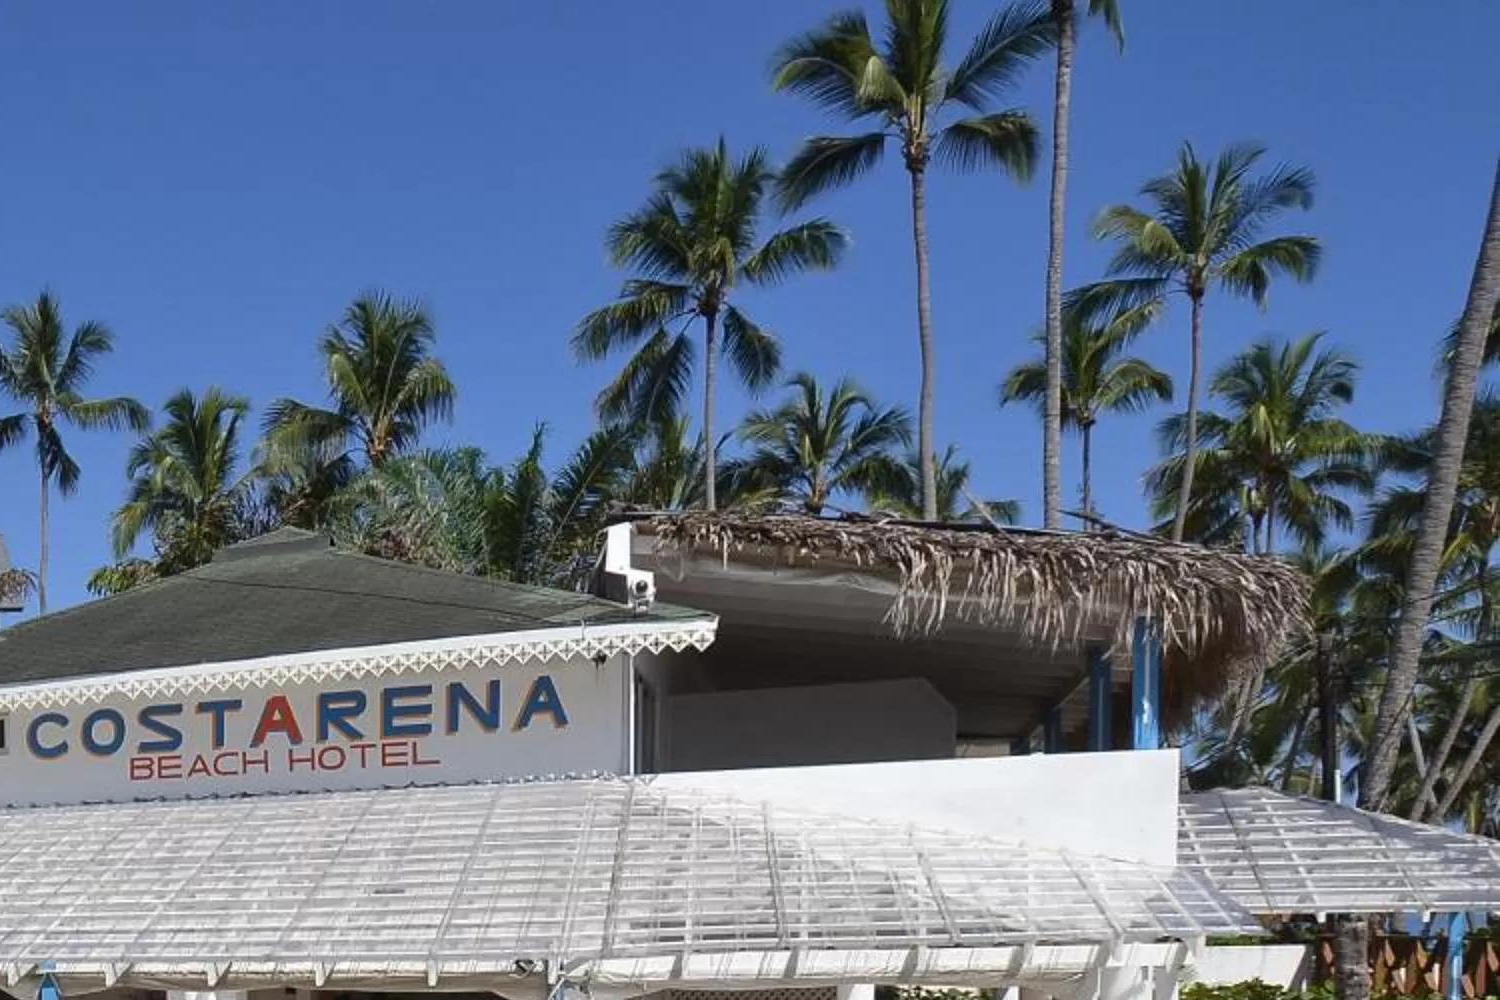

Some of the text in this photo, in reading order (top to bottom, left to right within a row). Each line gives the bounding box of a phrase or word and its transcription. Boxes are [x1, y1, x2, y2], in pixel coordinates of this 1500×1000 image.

[26, 675, 569, 759] COSTARENA
[130, 742, 441, 780] BEACH HOTEL
